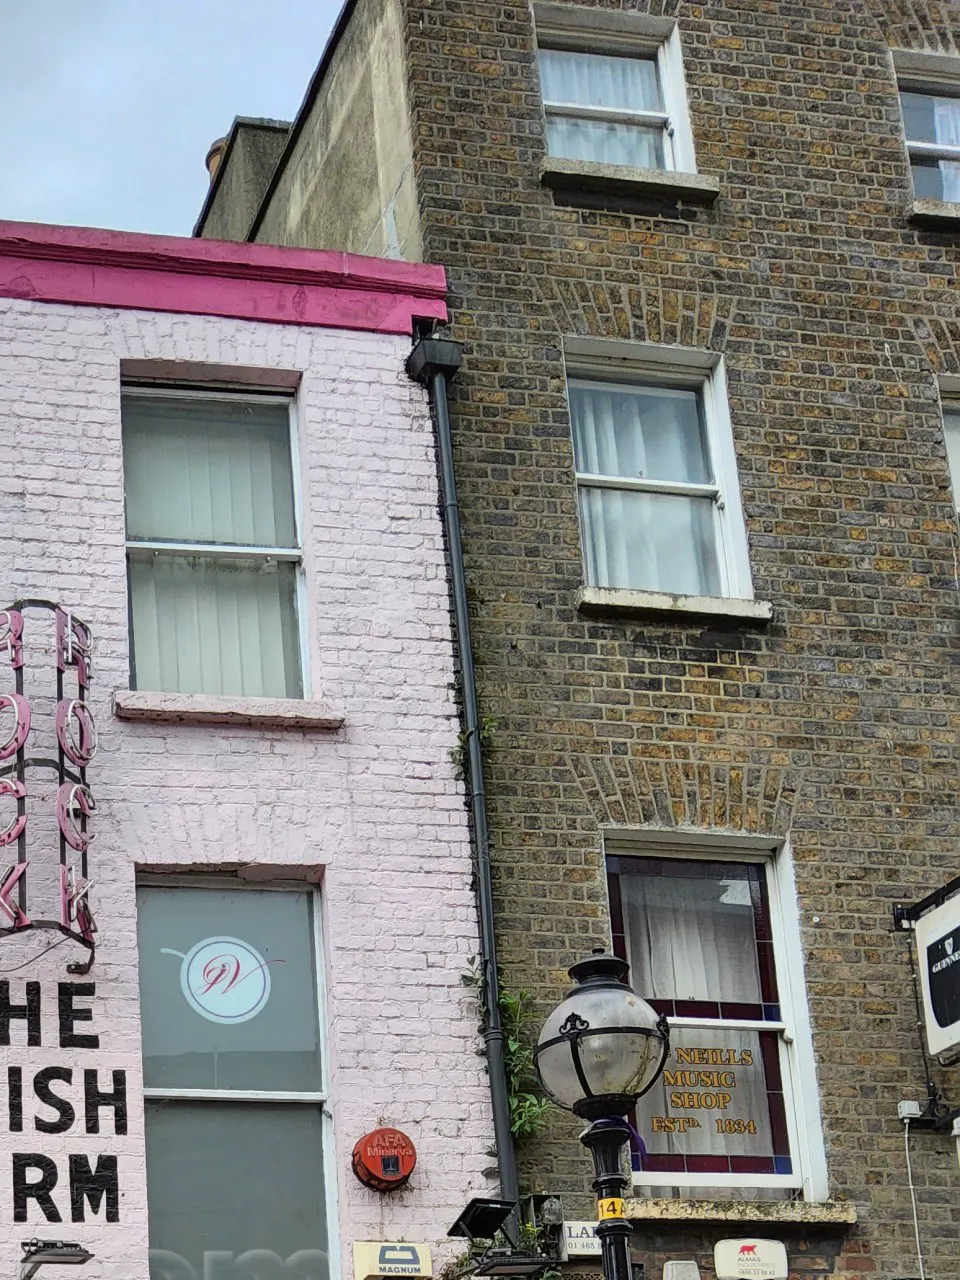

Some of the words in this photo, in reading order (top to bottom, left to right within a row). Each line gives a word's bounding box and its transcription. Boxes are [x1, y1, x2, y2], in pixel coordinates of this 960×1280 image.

[675, 1048, 753, 1066] NEILLS
[663, 1070, 736, 1088] MUSIC
[670, 1092, 731, 1109] SHOP
[715, 1118, 757, 1134] 1834
[373, 1134, 406, 1147] AFA
